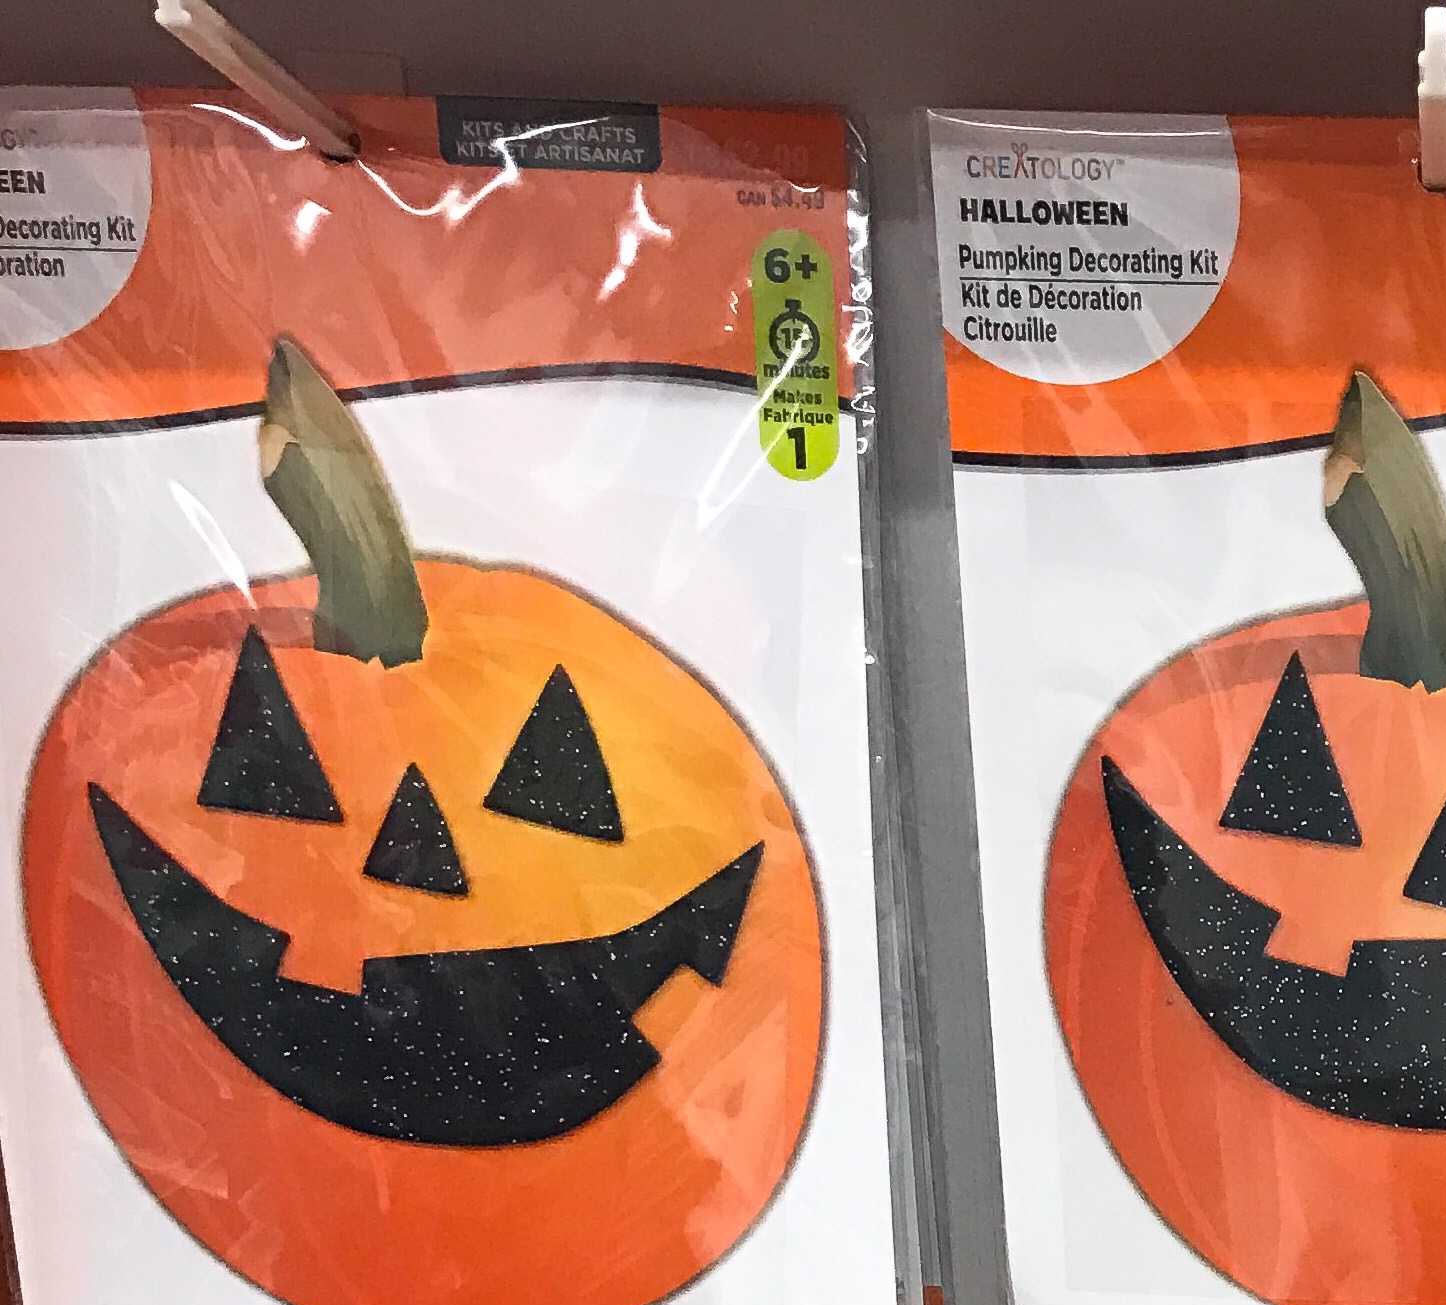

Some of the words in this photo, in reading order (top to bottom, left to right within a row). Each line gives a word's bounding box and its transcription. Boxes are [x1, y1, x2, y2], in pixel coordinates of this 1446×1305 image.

[960, 198, 1129, 226] HALLOWEEN
[106, 215, 136, 242] Kit
[763, 247, 818, 284] 6+
[958, 244, 1061, 277] Pumpking
[1070, 247, 1182, 278] Decorating
[1190, 250, 1219, 275] Kit
[961, 284, 990, 309] Kit
[996, 284, 1021, 309] de
[1029, 284, 1142, 311] Décoration
[963, 317, 1058, 343] Citrouille
